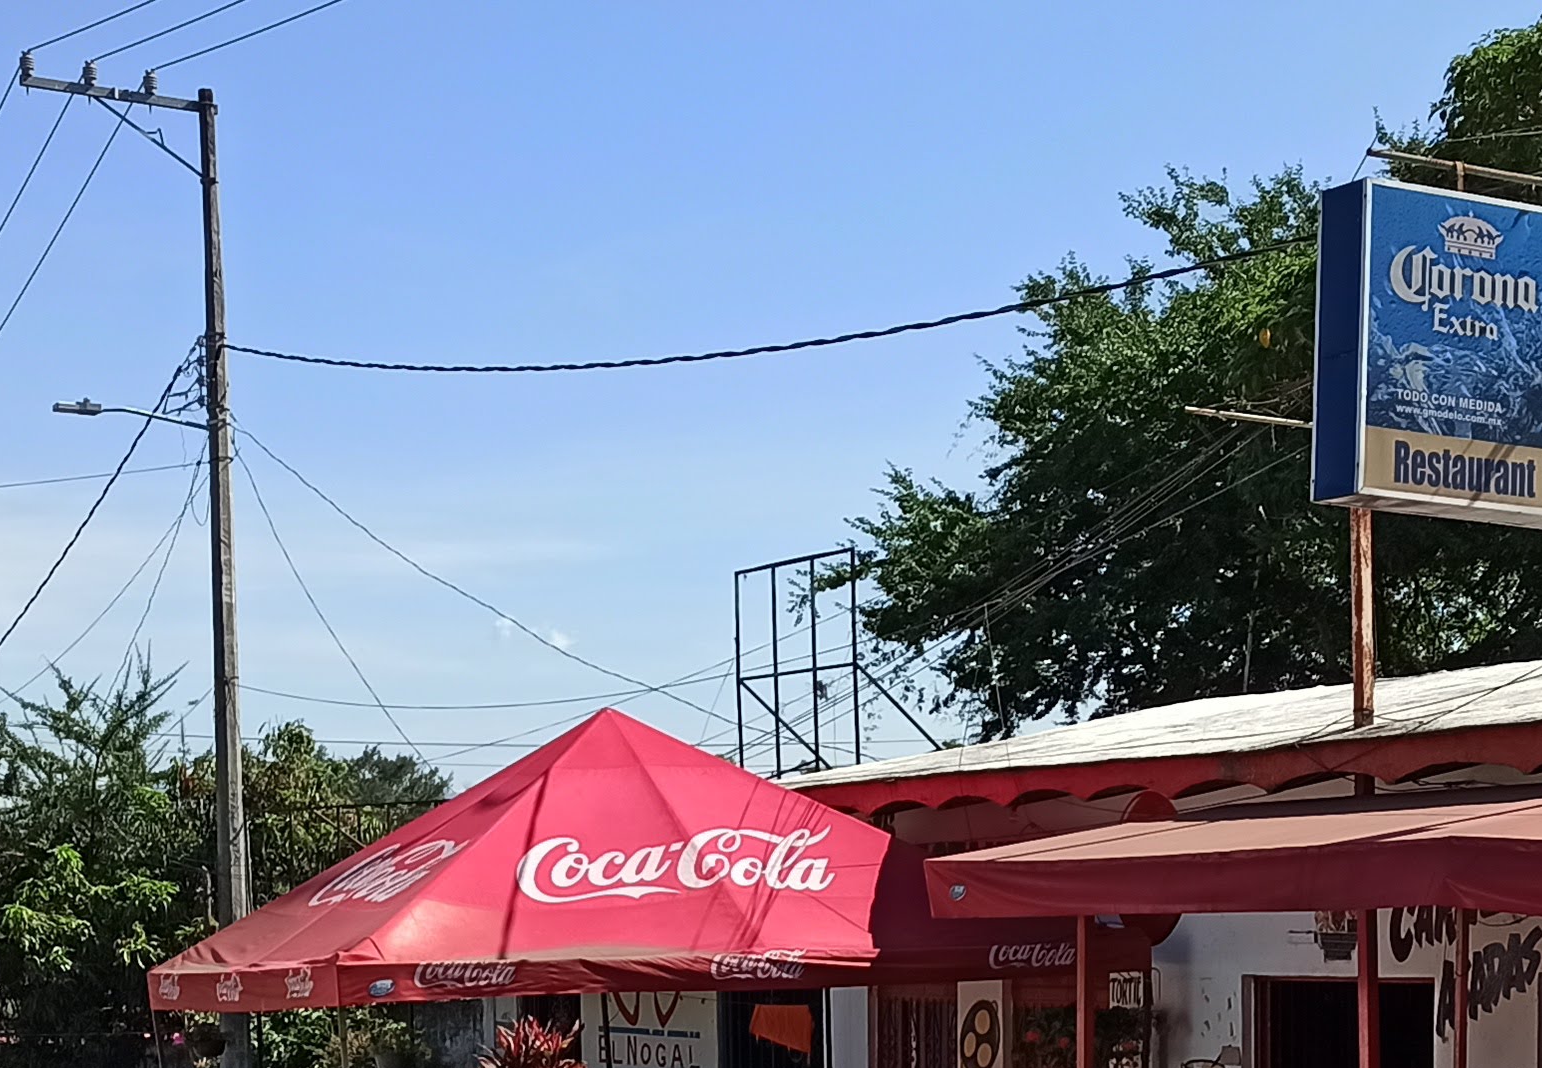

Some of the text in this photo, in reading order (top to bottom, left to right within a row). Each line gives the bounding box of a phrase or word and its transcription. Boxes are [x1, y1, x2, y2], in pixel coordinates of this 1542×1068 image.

[1389, 245, 1539, 313] Corona
[1432, 304, 1498, 341] Extra
[1396, 389, 1503, 414] TODO CON MEDIDA
[1394, 439, 1536, 498] Restaurant
